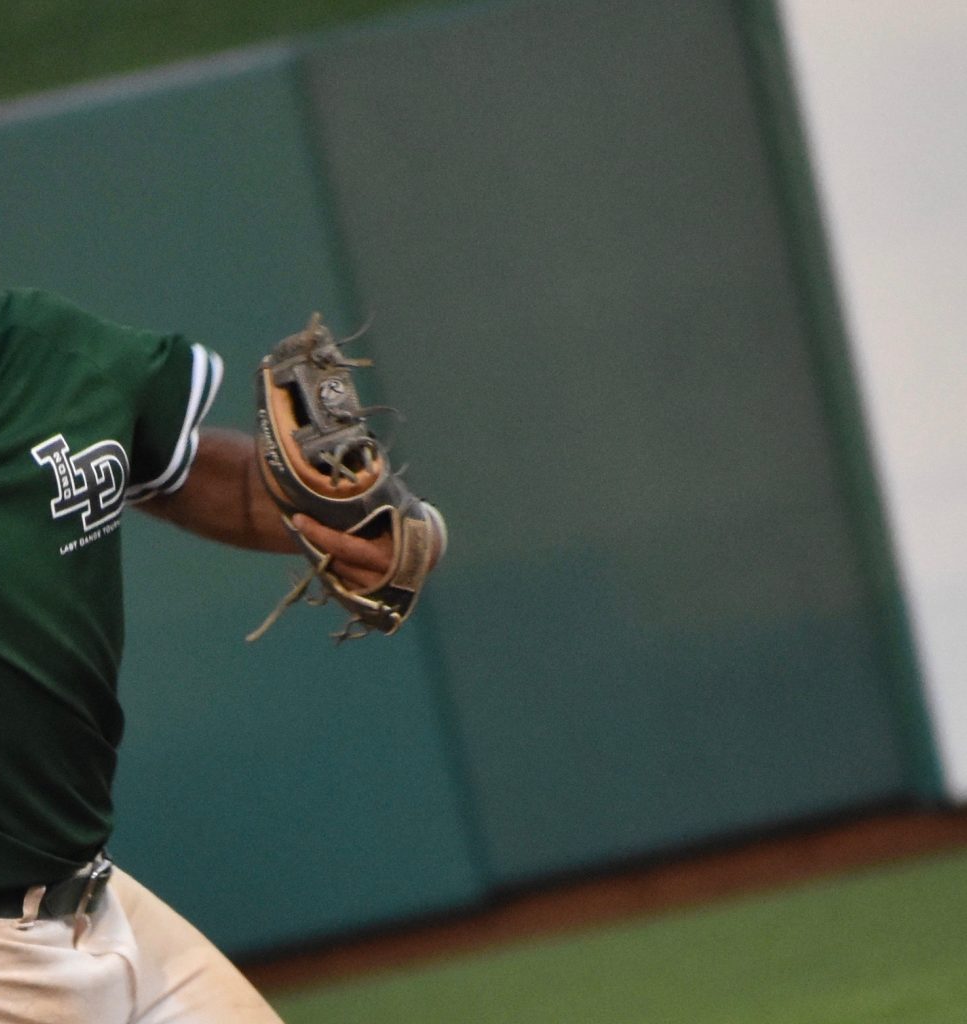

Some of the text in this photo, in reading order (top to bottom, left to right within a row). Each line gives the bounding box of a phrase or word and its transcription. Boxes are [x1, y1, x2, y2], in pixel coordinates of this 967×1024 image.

[31, 433, 130, 531] LD
[53, 452, 71, 500] 2020
[60, 540, 78, 555] LAST
[79, 529, 102, 547] DANCE
